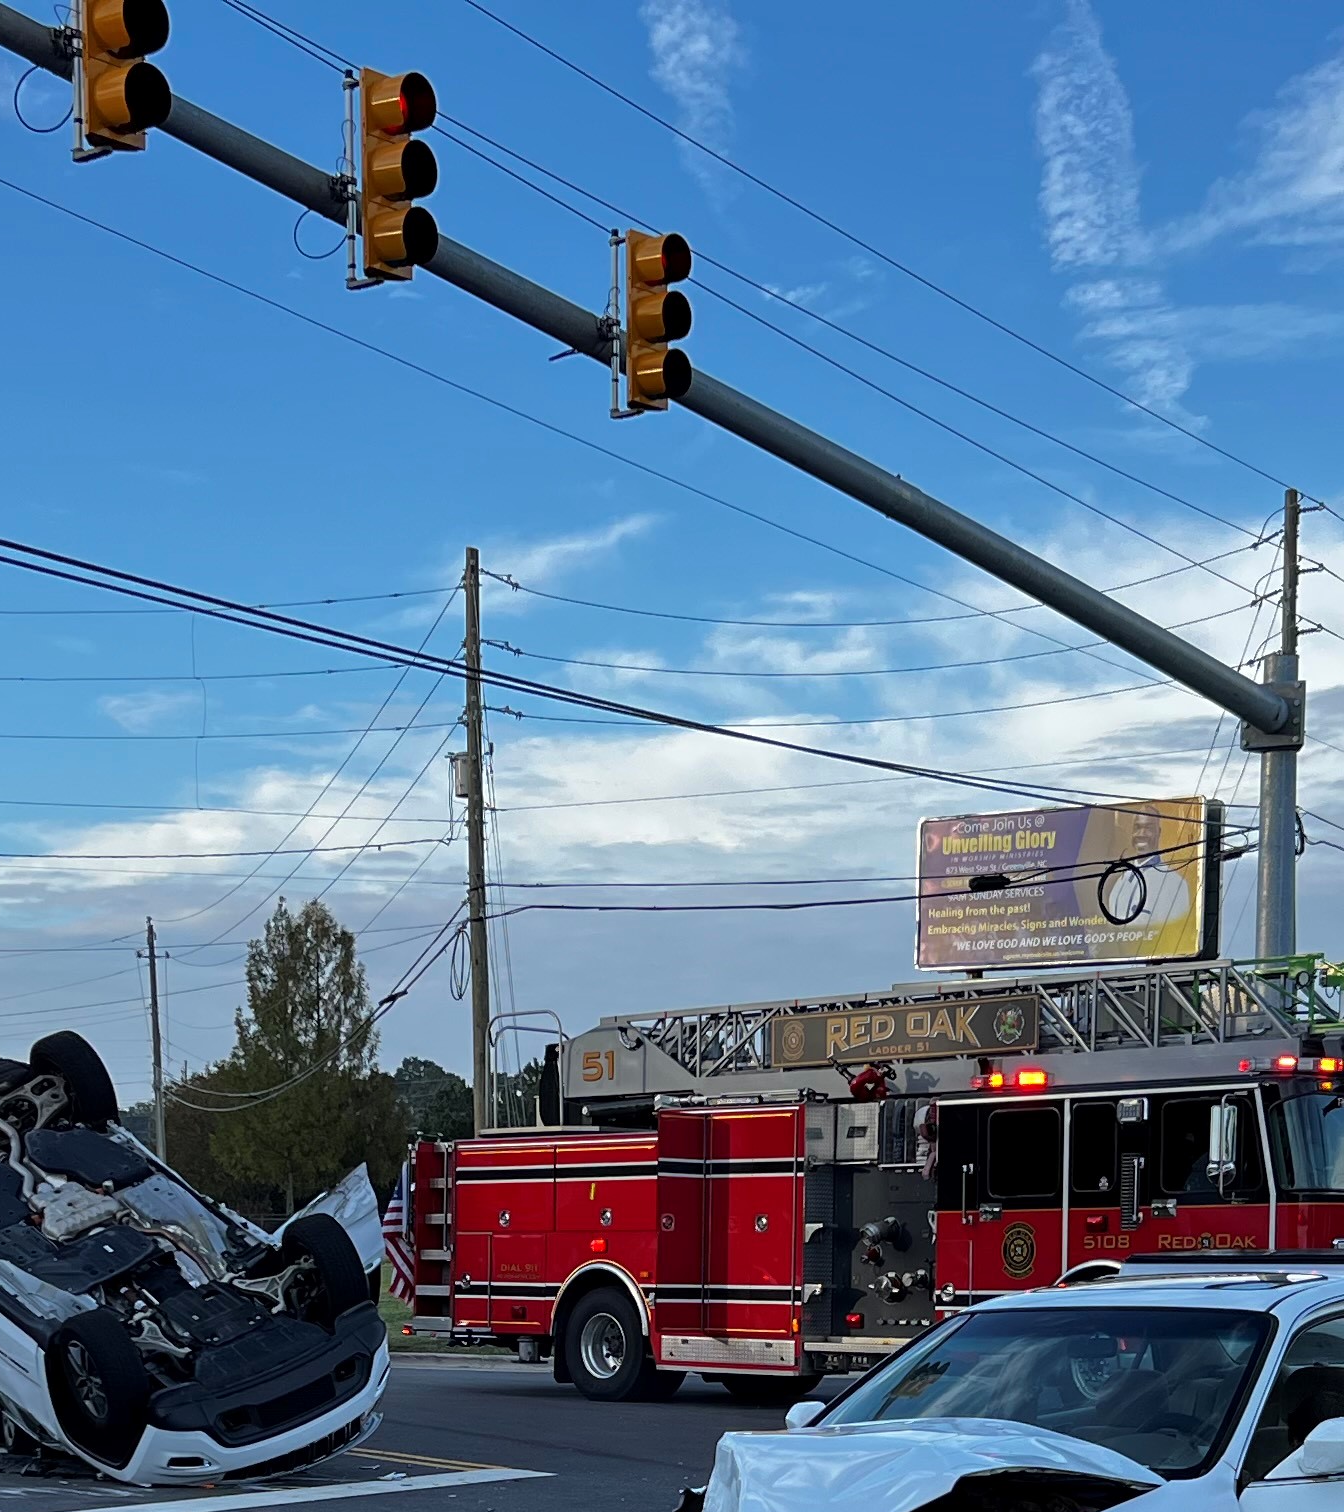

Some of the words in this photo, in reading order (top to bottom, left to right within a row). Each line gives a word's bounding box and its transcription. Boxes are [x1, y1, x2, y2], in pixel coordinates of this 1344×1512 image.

[957, 821, 989, 834] Come
[992, 817, 1014, 832] Join
[1018, 815, 1032, 829] Us
[1034, 814, 1045, 828] @
[942, 833, 1013, 855] Unveiling
[1015, 830, 1056, 850] Glory
[1000, 850, 1044, 860] MINISTRIES
[969, 890, 1003, 902] SUNDAY
[1005, 886, 1045, 898] SERVICES
[928, 908, 964, 919] Healing
[966, 906, 988, 916] from
[990, 904, 1006, 915] the
[1007, 903, 1031, 916] past!
[928, 923, 977, 936] Embracing
[1021, 919, 1047, 932] Signs
[1048, 917, 1067, 928] and
[1068, 914, 1108, 927] Wonder
[971, 940, 995, 950] LOVE
[997, 939, 1017, 949] GOD
[1019, 937, 1040, 947] AND
[1042, 936, 1057, 946] WE
[1058, 934, 1083, 946] LOVE
[1084, 932, 1115, 944] GOD'S
[826, 1013, 895, 1059] RED
[906, 1004, 982, 1048] OAK
[869, 1044, 912, 1056] LADDER
[916, 1043, 930, 1053] 51
[582, 1050, 615, 1082] 51
[1083, 1234, 1130, 1249] 5108
[1158, 1233, 1196, 1249] RED
[1215, 1233, 1257, 1249] OAK
[500, 1263, 522, 1272] DIAL
